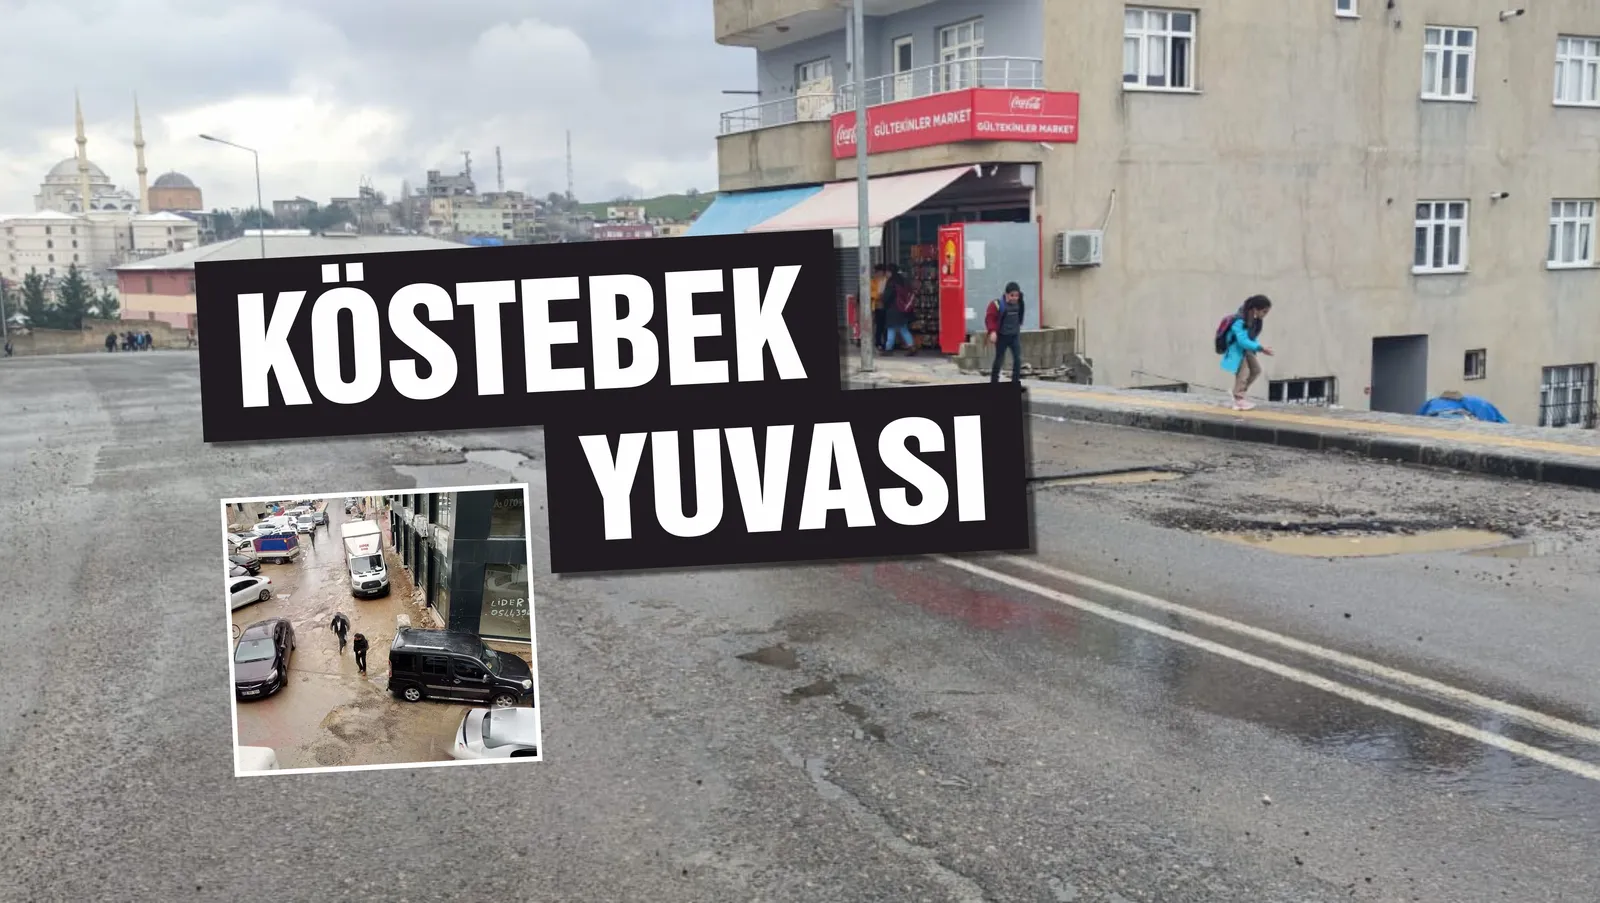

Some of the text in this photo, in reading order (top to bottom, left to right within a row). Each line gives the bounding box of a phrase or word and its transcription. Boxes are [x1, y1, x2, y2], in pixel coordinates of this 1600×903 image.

[874, 108, 972, 137] GÜLTEKİNLER MARKET
[976, 121, 1075, 135] GÜLTEKİNLER MARKET
